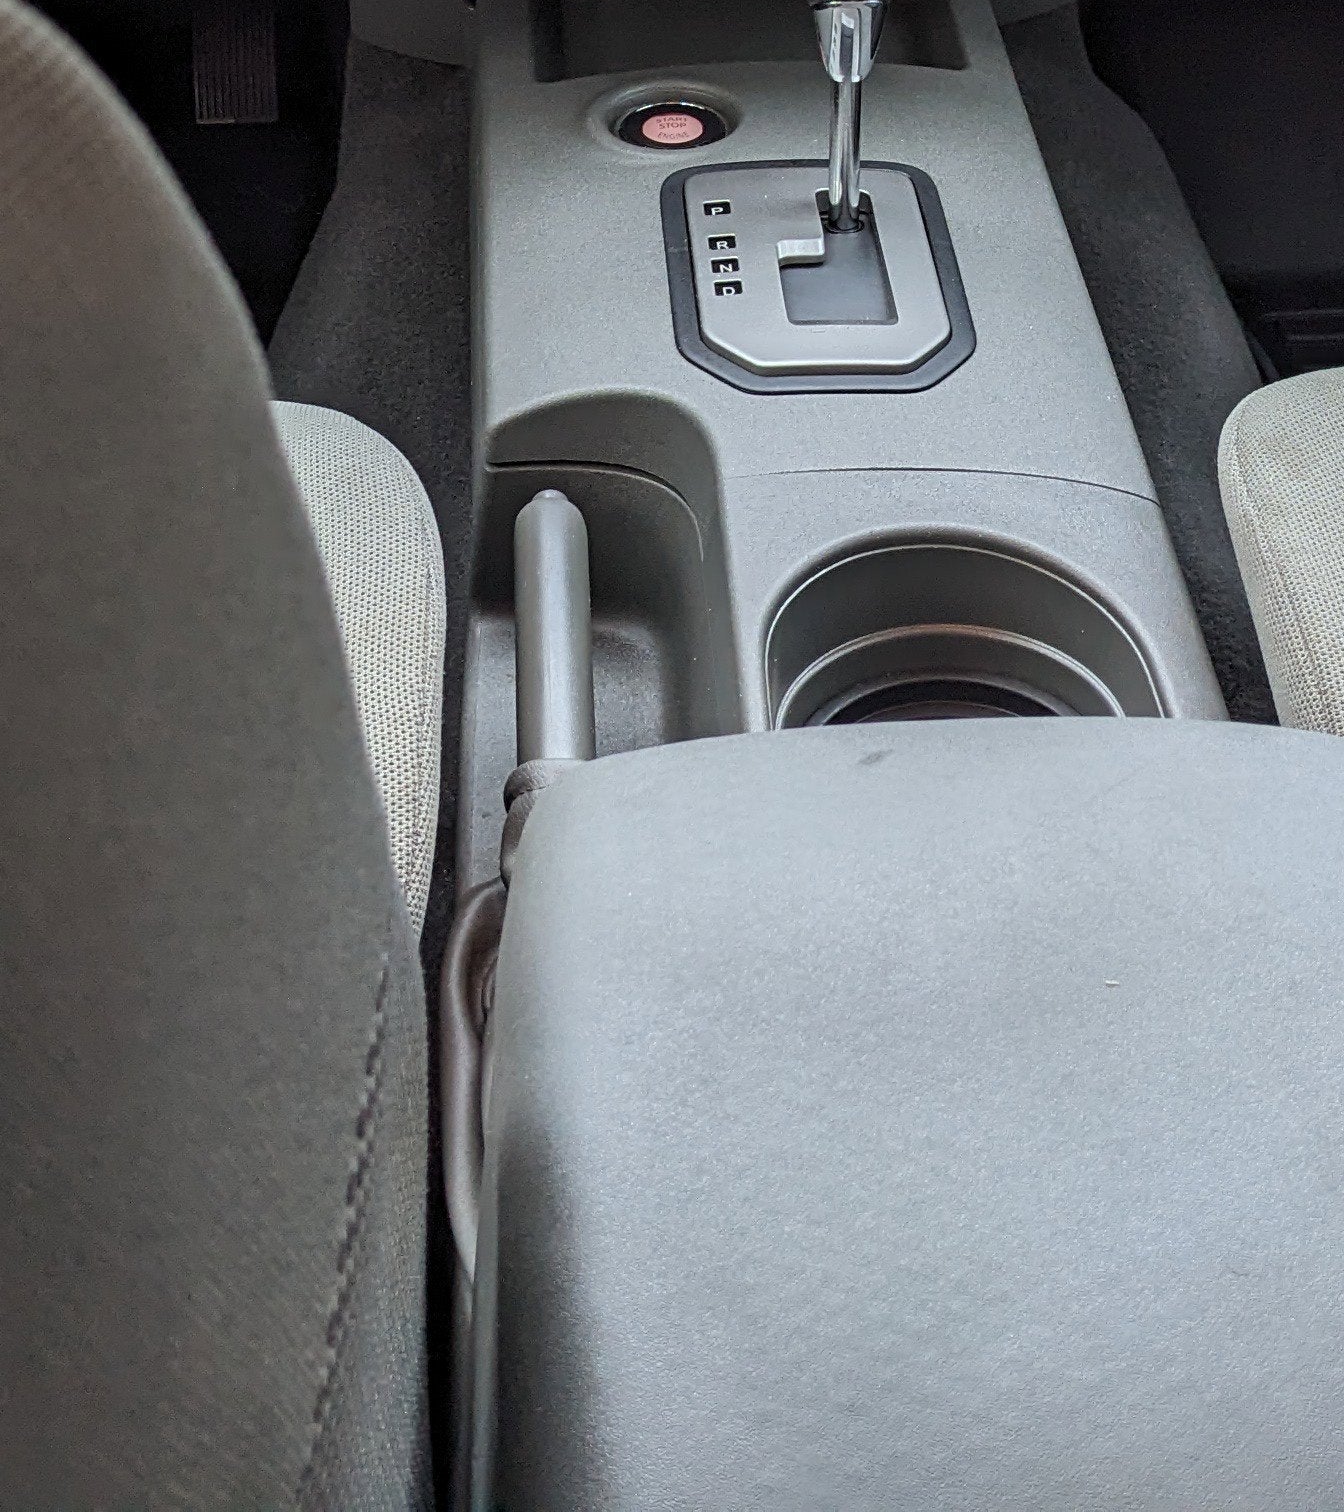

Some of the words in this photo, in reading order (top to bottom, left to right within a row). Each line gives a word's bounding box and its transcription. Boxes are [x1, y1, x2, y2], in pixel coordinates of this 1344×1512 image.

[711, 207, 723, 215] P
[716, 240, 729, 249] R
[719, 263, 732, 273] N
[722, 286, 735, 296] D
